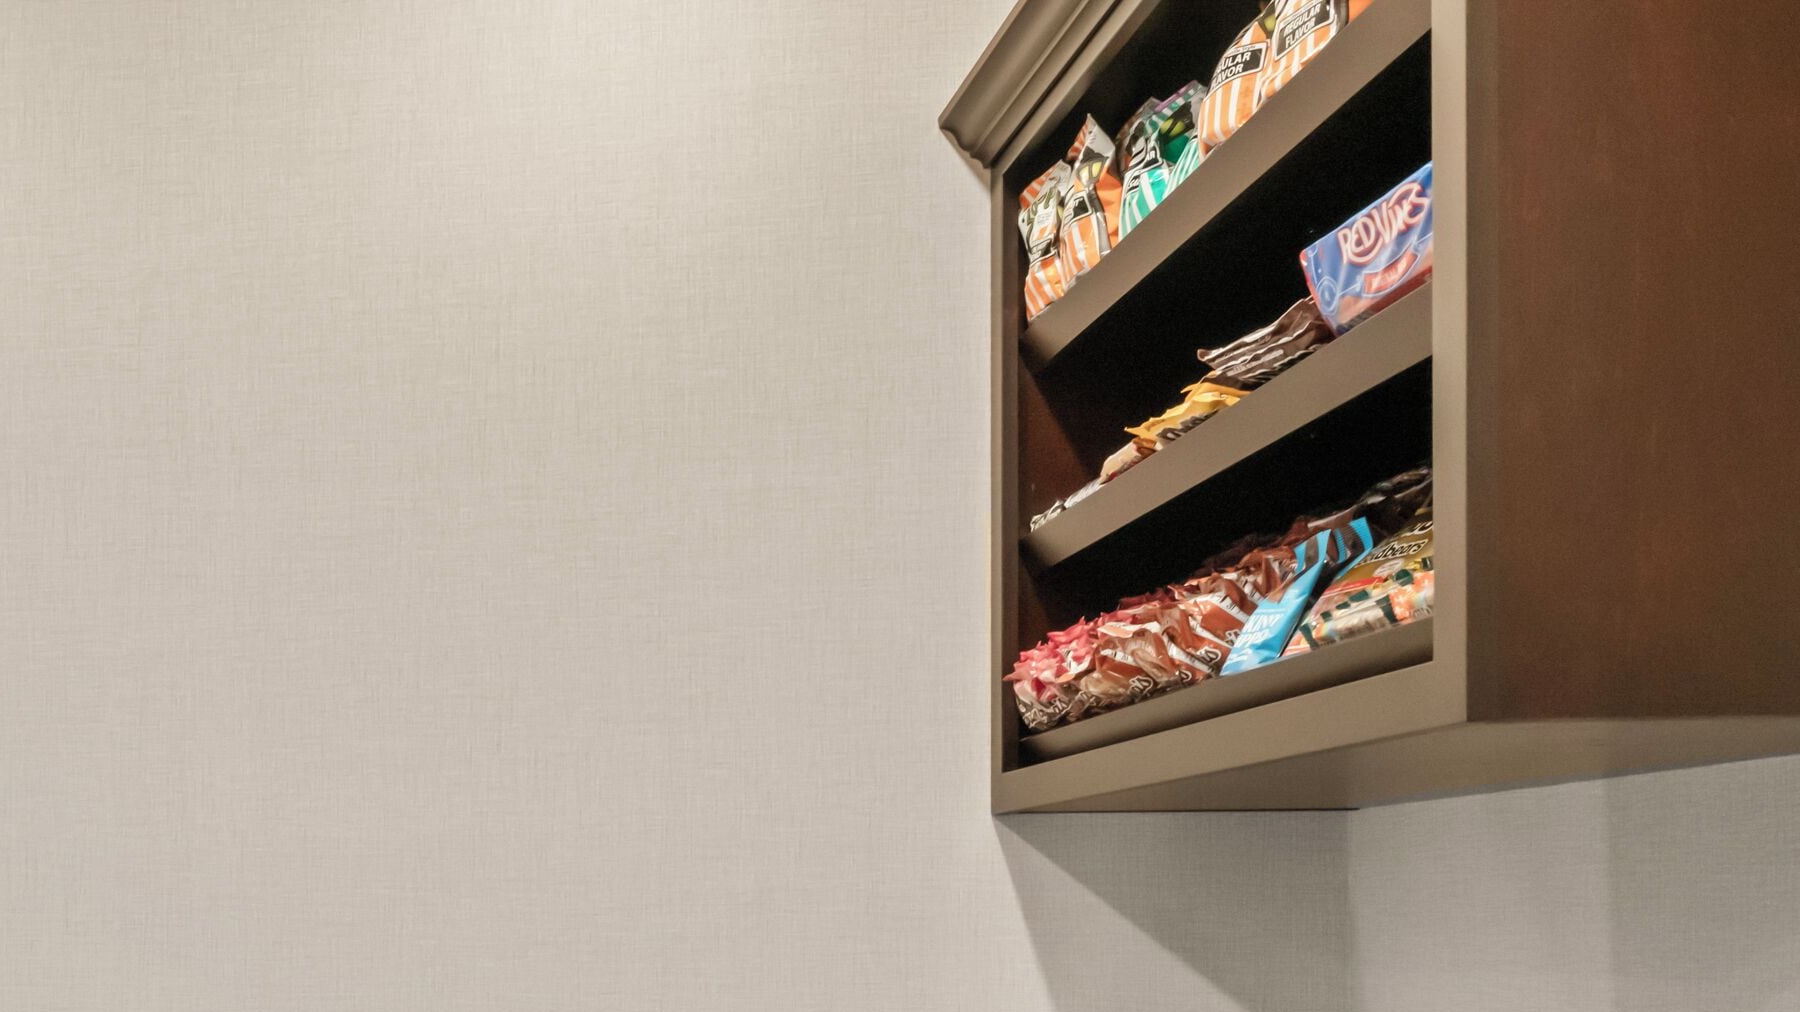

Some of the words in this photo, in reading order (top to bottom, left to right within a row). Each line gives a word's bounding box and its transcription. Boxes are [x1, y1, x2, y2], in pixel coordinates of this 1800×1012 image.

[1283, 3, 1322, 37] REGULAR
[1284, 17, 1316, 49] FLAVOR
[1216, 51, 1251, 73] GULAR
